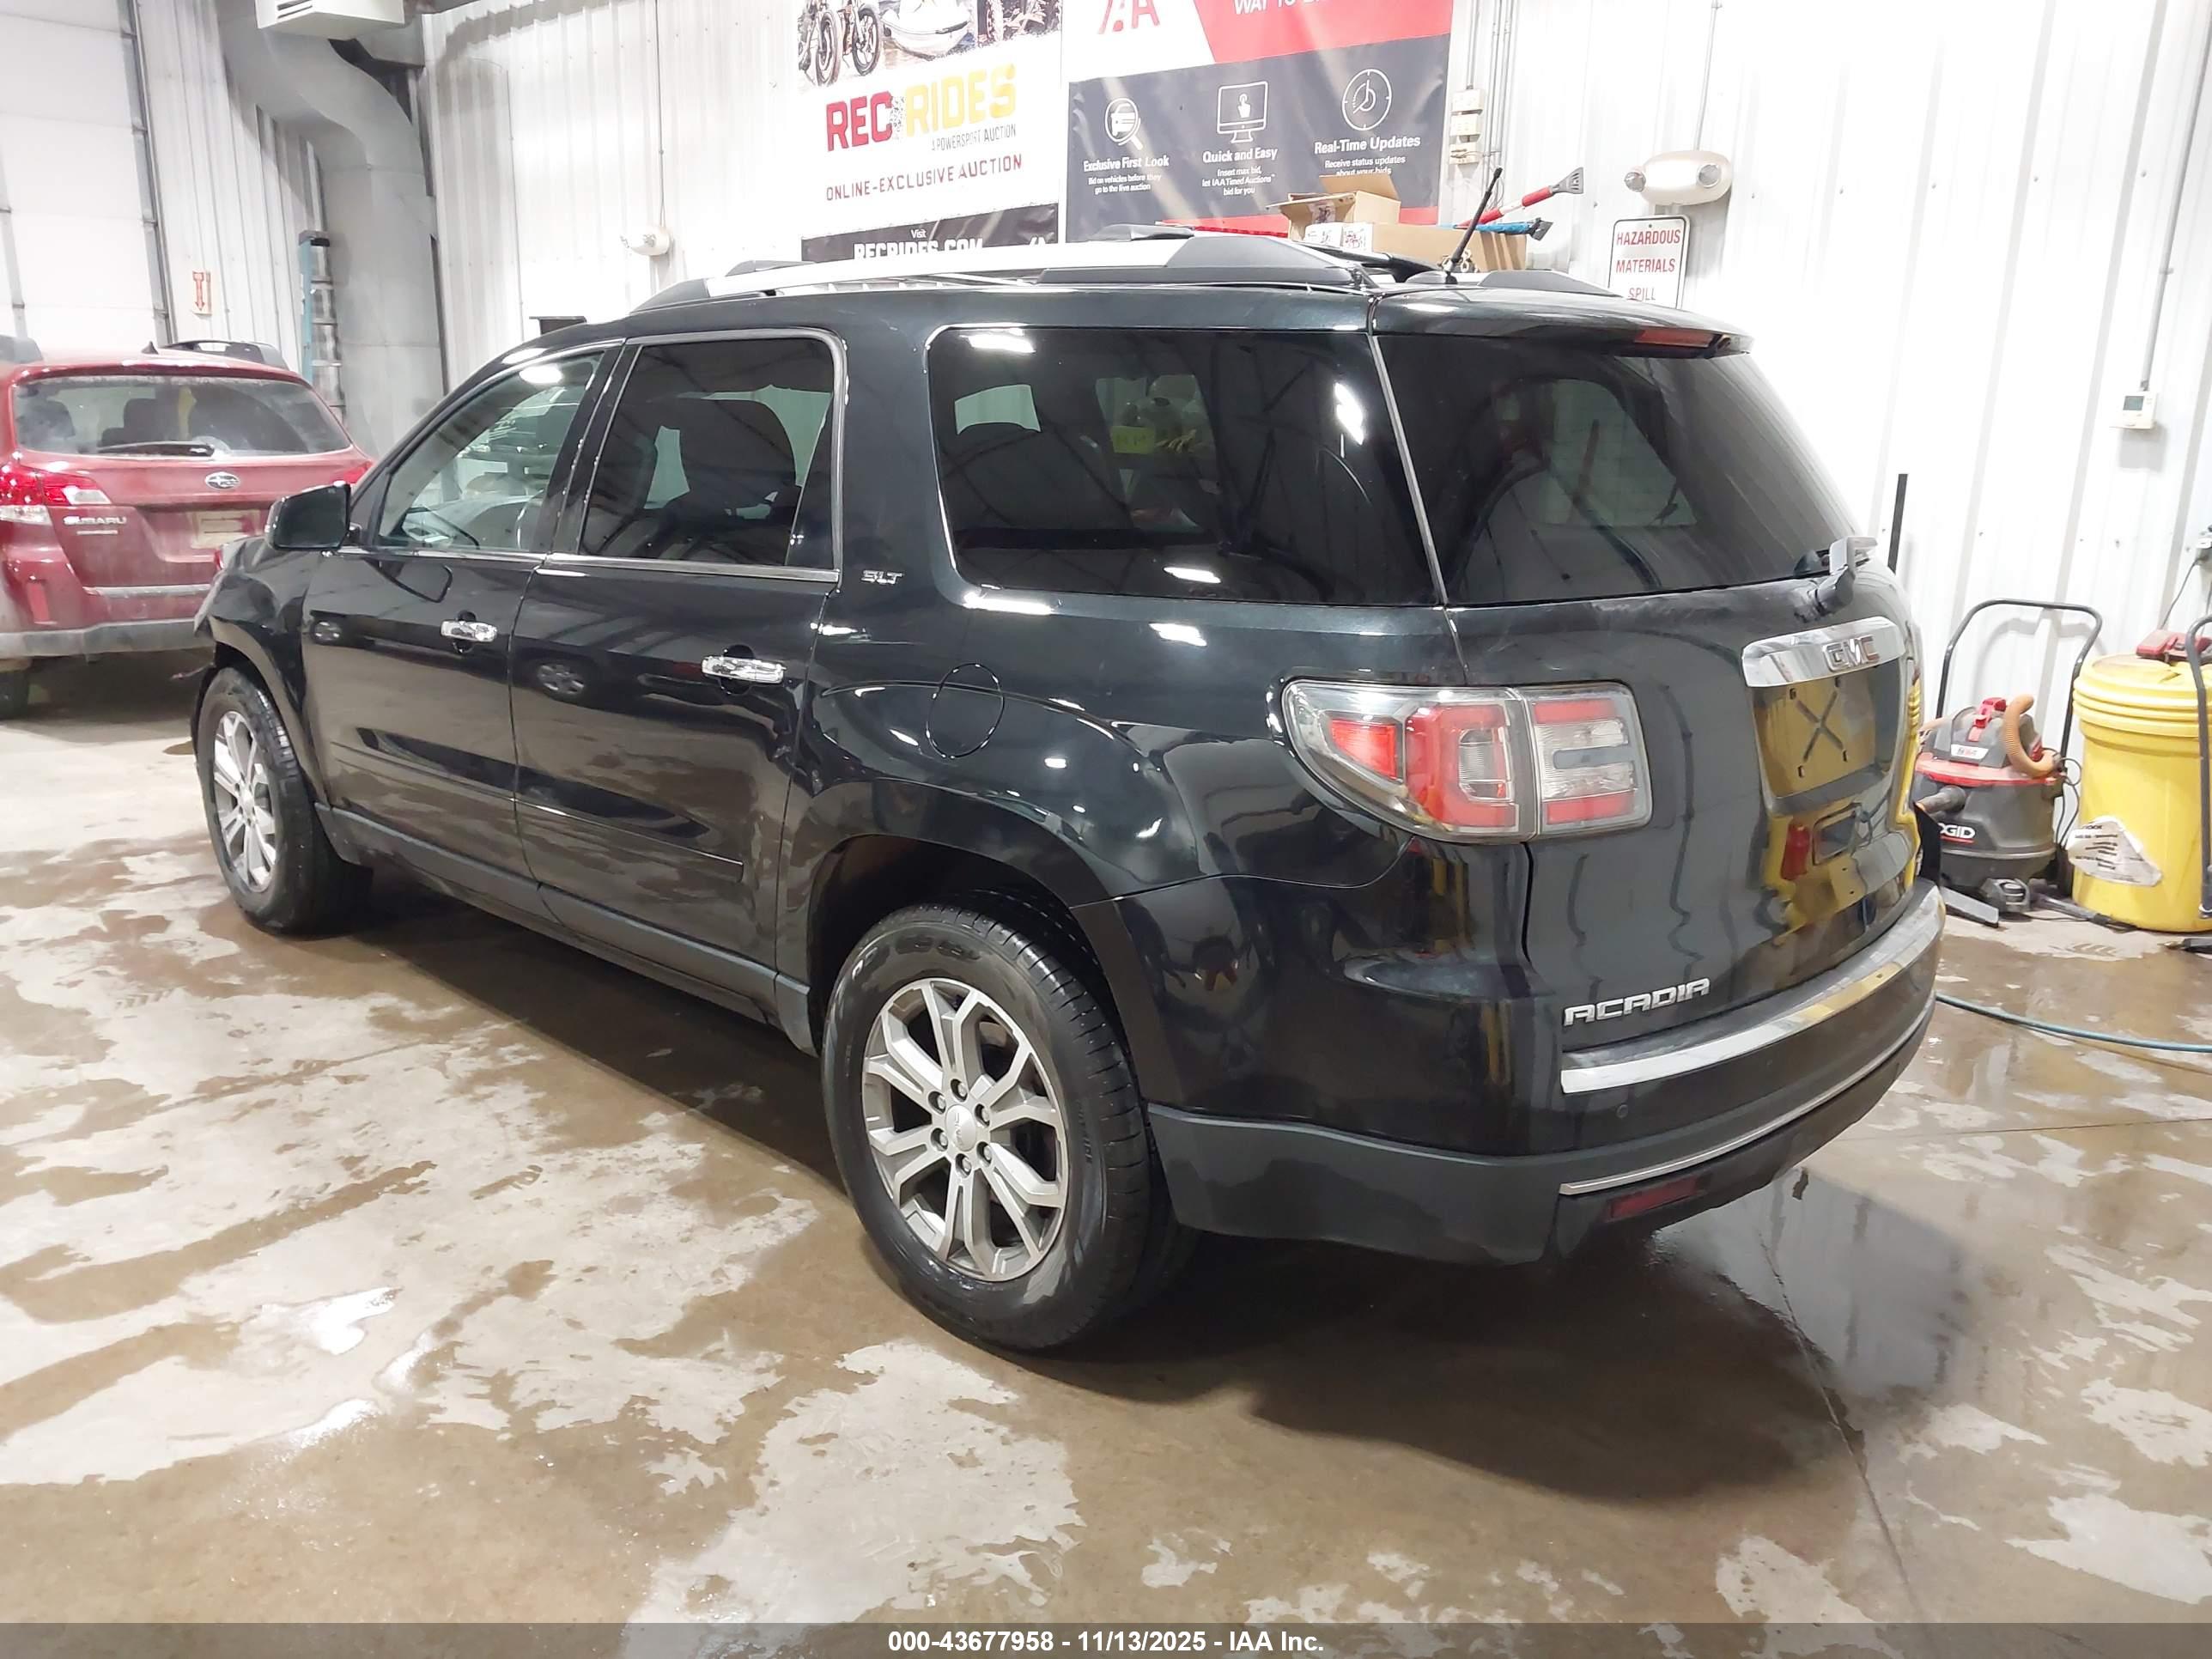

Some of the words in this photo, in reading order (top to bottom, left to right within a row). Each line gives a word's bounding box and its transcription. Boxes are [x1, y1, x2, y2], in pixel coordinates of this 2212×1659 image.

[826, 91, 893, 152] REC
[906, 63, 1017, 137] RIDES
[937, 130, 981, 150] POWERSPORT
[984, 124, 1017, 143] AUCTION
[1314, 139, 1367, 155] Real-Time
[1370, 136, 1421, 151] Updates
[1202, 150, 1233, 163] Quick
[1234, 149, 1253, 161] and
[1255, 147, 1278, 161] Easy
[1324, 160, 1351, 168] Receive
[1352, 157, 1373, 167] status
[1375, 155, 1406, 166] updates
[1083, 159, 1121, 172] Exclusive
[1121, 156, 1142, 169] First
[1145, 155, 1170, 167] Look
[826, 166, 955, 201] ONLINE-EXCLUSIVE
[957, 154, 1022, 179] AUCTION
[1104, 174, 1127, 183] vehicles
[1127, 173, 1146, 182] before
[1217, 168, 1235, 177] Insert
[1223, 187, 1234, 196] bid
[1243, 186, 1255, 195] you
[910, 228, 927, 239] Visit
[1616, 229, 1681, 246] HAZARDOUS
[1615, 258, 1676, 273] MATERIALS
[1628, 287, 1656, 301] SPILL
[860, 569, 902, 585] SLT
[1822, 635, 1881, 673] GMC
[1563, 977, 1711, 1027] ACADIA
